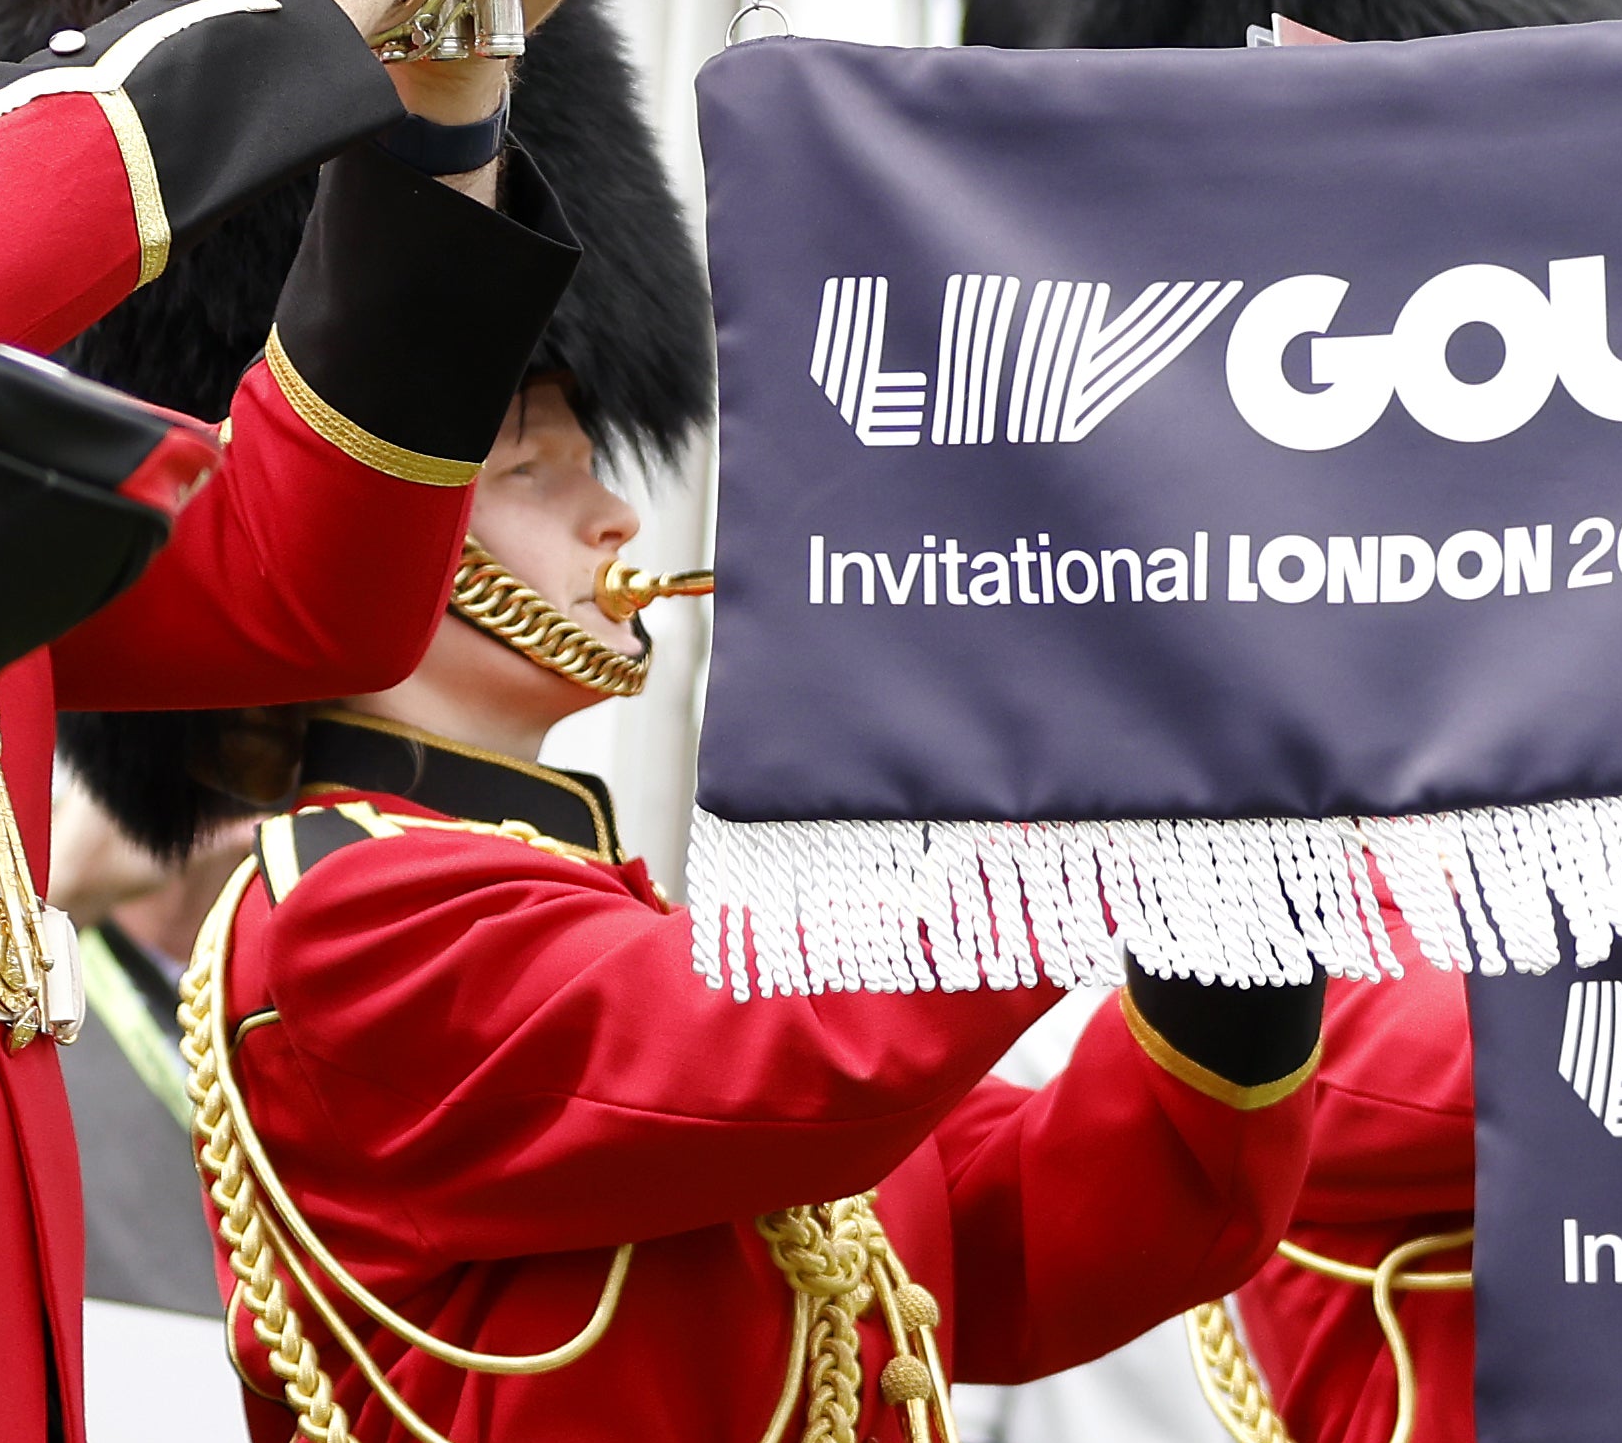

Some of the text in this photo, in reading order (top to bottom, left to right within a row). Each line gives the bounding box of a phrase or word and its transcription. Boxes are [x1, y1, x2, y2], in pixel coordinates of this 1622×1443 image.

[809, 274, 1243, 446] LIV
[809, 530, 1208, 605] Invitational
[1227, 524, 1553, 604] LONDON
